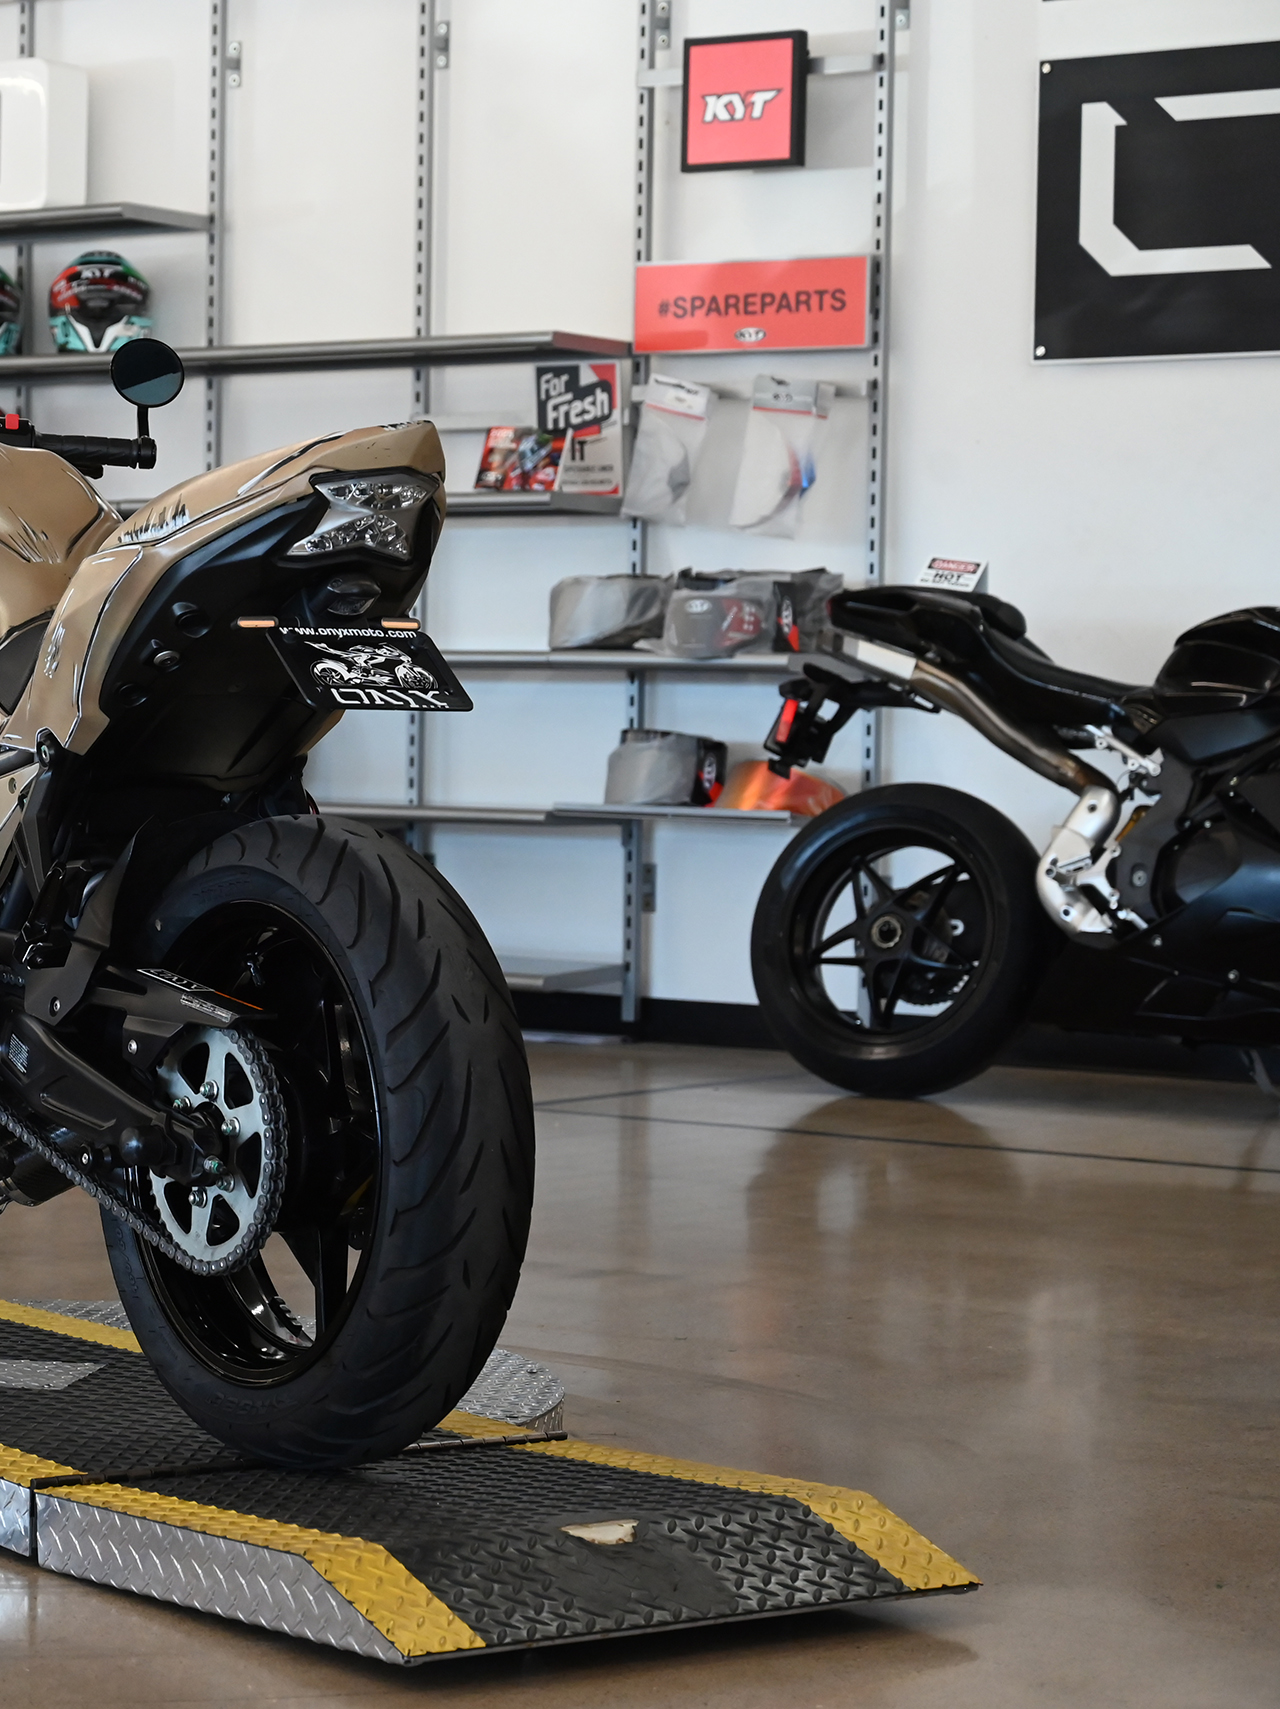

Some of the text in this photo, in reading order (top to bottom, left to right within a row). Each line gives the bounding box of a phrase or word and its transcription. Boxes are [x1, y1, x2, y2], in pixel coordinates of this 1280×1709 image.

[701, 88, 782, 123] KYT
[658, 288, 847, 319] #SPAREPARTS
[539, 372, 570, 401] For
[546, 387, 610, 430] Fresh
[331, 688, 449, 709] ONYX
